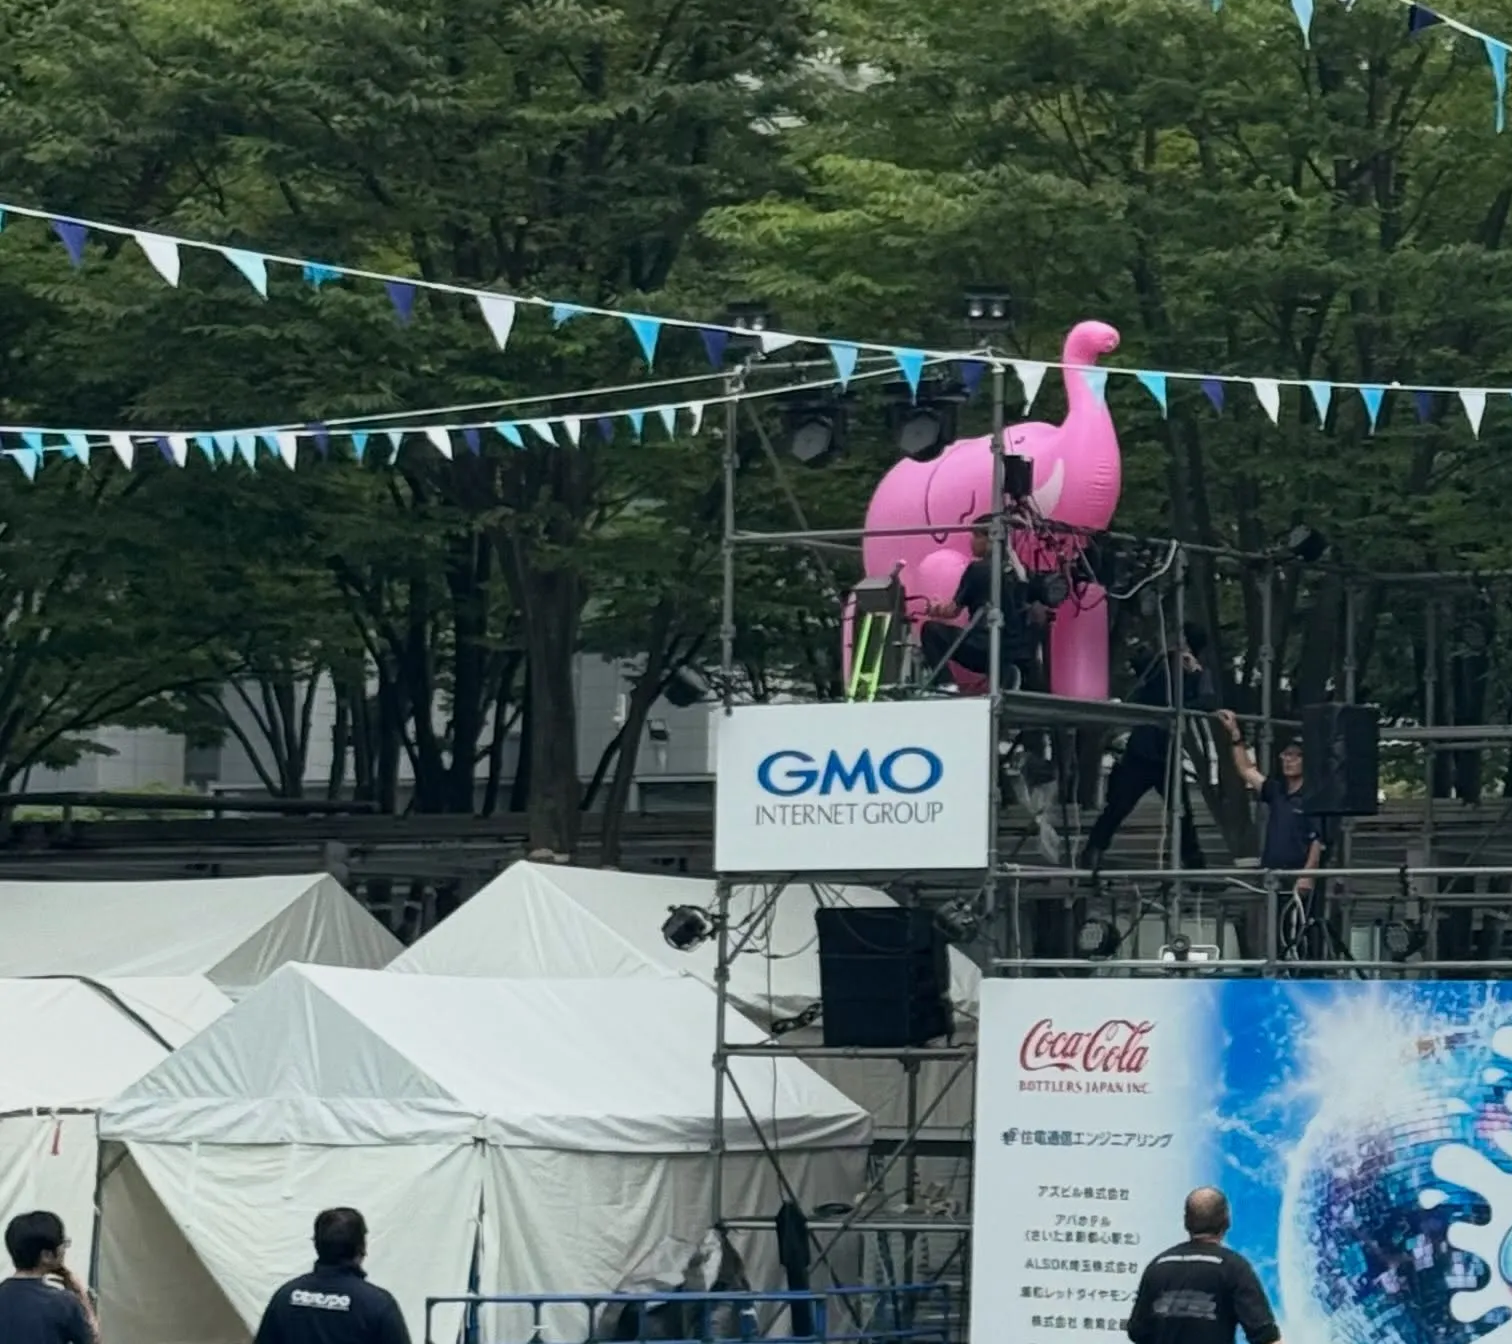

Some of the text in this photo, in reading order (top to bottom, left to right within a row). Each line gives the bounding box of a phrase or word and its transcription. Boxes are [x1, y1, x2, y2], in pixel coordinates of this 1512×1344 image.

[757, 747, 943, 796] GMO
[755, 801, 943, 826] INTERNET GROUP
[1019, 1018, 1158, 1073] Coca-Cola
[1019, 1080, 1082, 1093] BOTTLERS
[1085, 1081, 1123, 1094] JAPAN
